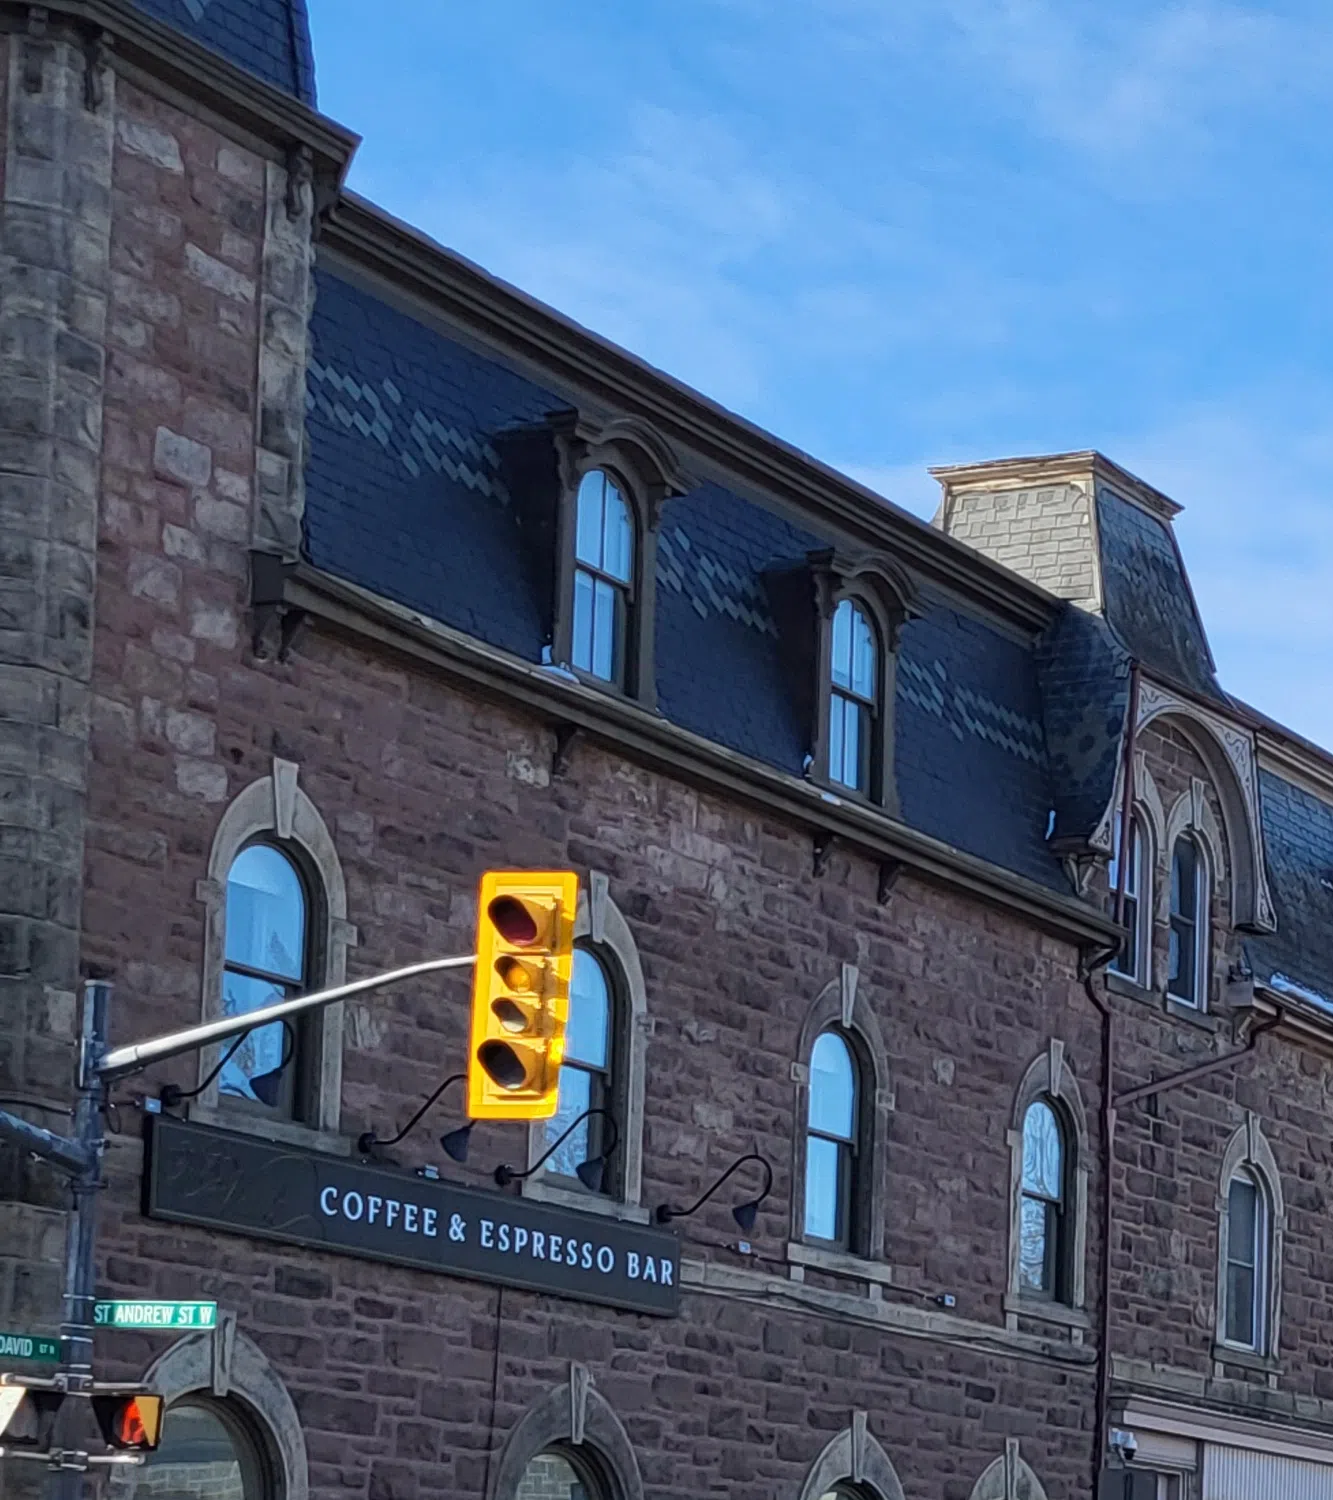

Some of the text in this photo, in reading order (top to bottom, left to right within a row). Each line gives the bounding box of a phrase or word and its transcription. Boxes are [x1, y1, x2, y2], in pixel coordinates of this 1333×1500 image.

[320, 1186, 674, 1287] COFFEE & ESPRESSO BAR
[93, 1304, 213, 1324] ST ANDREW ST W
